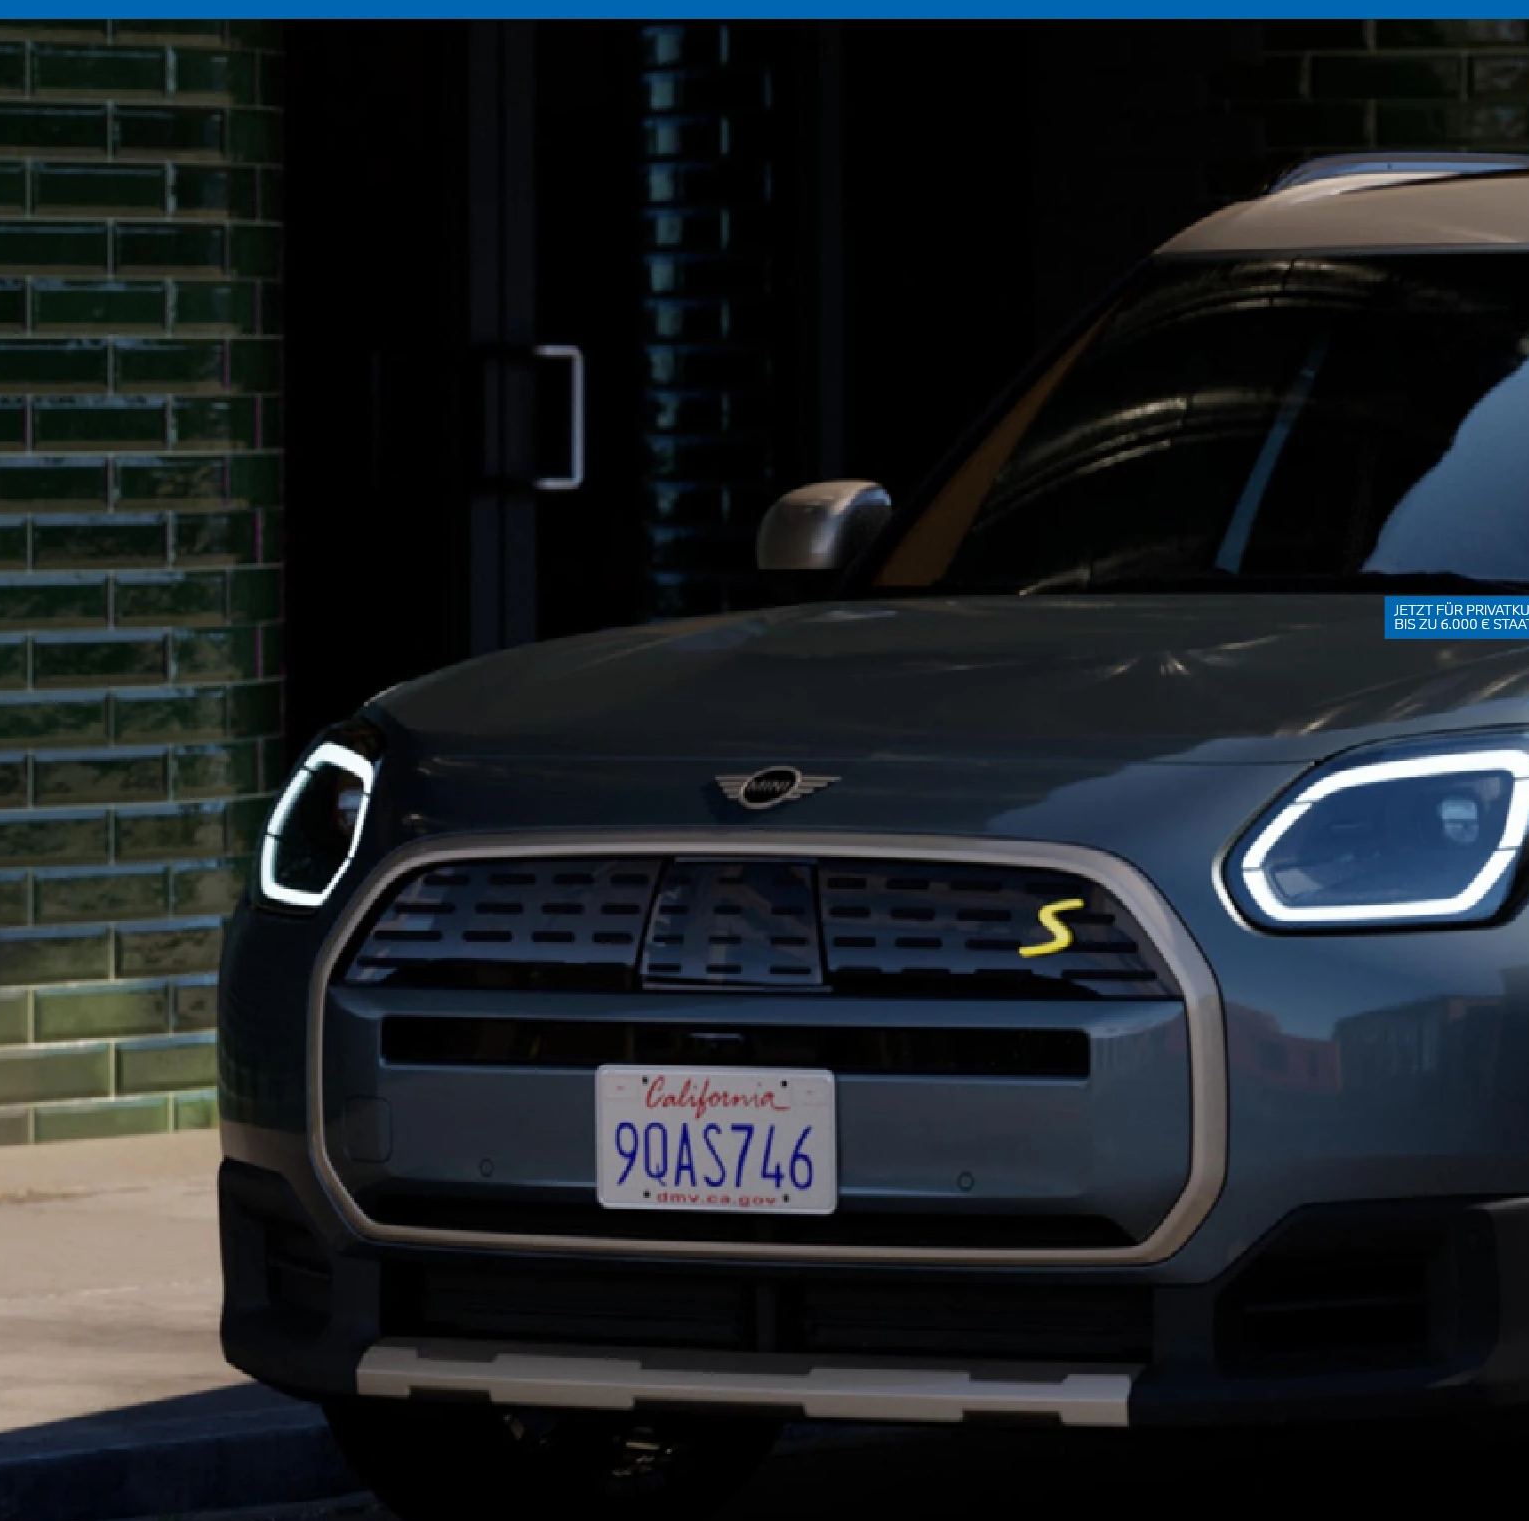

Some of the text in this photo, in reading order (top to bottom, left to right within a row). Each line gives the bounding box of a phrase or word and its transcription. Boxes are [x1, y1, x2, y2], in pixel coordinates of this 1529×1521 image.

[1018, 898, 1085, 958] S
[645, 1075, 790, 1119] California
[615, 1121, 813, 1190] 9QAS746
[657, 1192, 776, 1208] dmv.ca.gov
